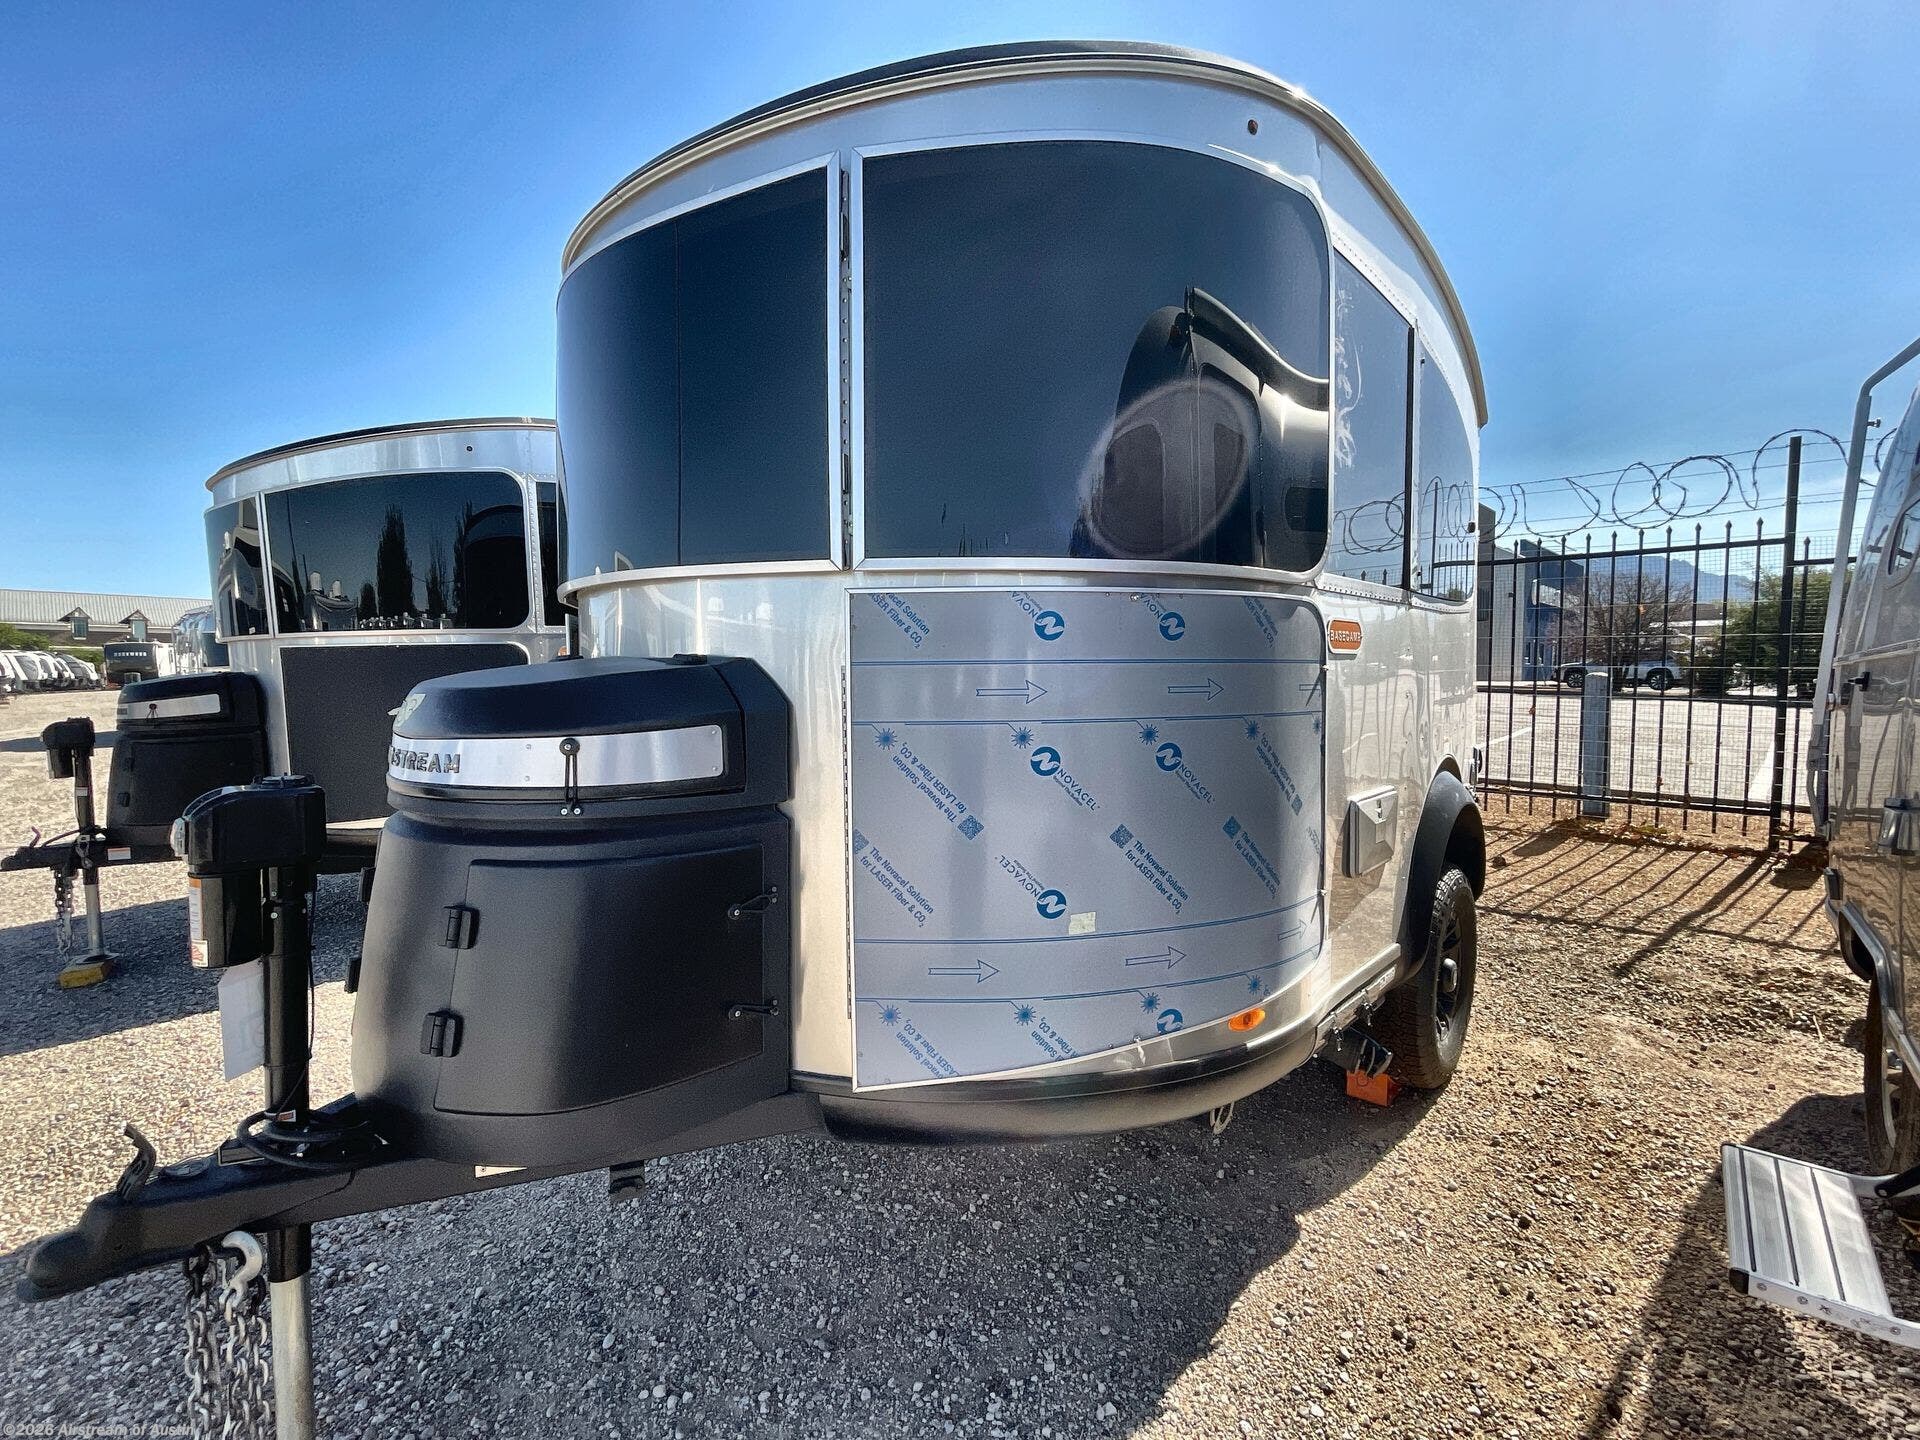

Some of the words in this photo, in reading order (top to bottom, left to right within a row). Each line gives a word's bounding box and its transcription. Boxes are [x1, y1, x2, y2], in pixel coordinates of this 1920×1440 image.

[886, 608, 906, 628] Fiber
[904, 625, 912, 634] &
[902, 605, 930, 635] Solution
[892, 755, 920, 784] Solution
[911, 756, 919, 765] &
[917, 763, 936, 782] Fiber
[917, 781, 946, 810] Novacel
[933, 779, 957, 803] LASER
[944, 807, 957, 822] The
[955, 801, 967, 814] for
[1241, 831, 1251, 844] The
[1235, 839, 1243, 851] for
[1241, 848, 1258, 869] LASER
[870, 846, 883, 863] The
[881, 859, 910, 888] Novacel
[906, 885, 934, 914] Solution
[1125, 849, 1136, 862] for
[1134, 858, 1155, 882] LASER
[1152, 878, 1168, 896] Fiber
[1166, 893, 1174, 902] &
[1133, 840, 1146, 855] The
[1144, 851, 1169, 878] Novacel
[1165, 875, 1189, 901] Solution
[860, 855, 873, 869] for
[870, 865, 894, 891] LASER
[891, 887, 910, 907] Fiber
[908, 904, 916, 913] &
[896, 1031, 923, 1060] Solution
[914, 1033, 922, 1042] &
[1031, 1030, 1058, 1058] Solution
[1049, 1030, 1057, 1039] &
[1055, 1036, 1073, 1054] Fiber
[920, 1039, 939, 1059] Fiber
